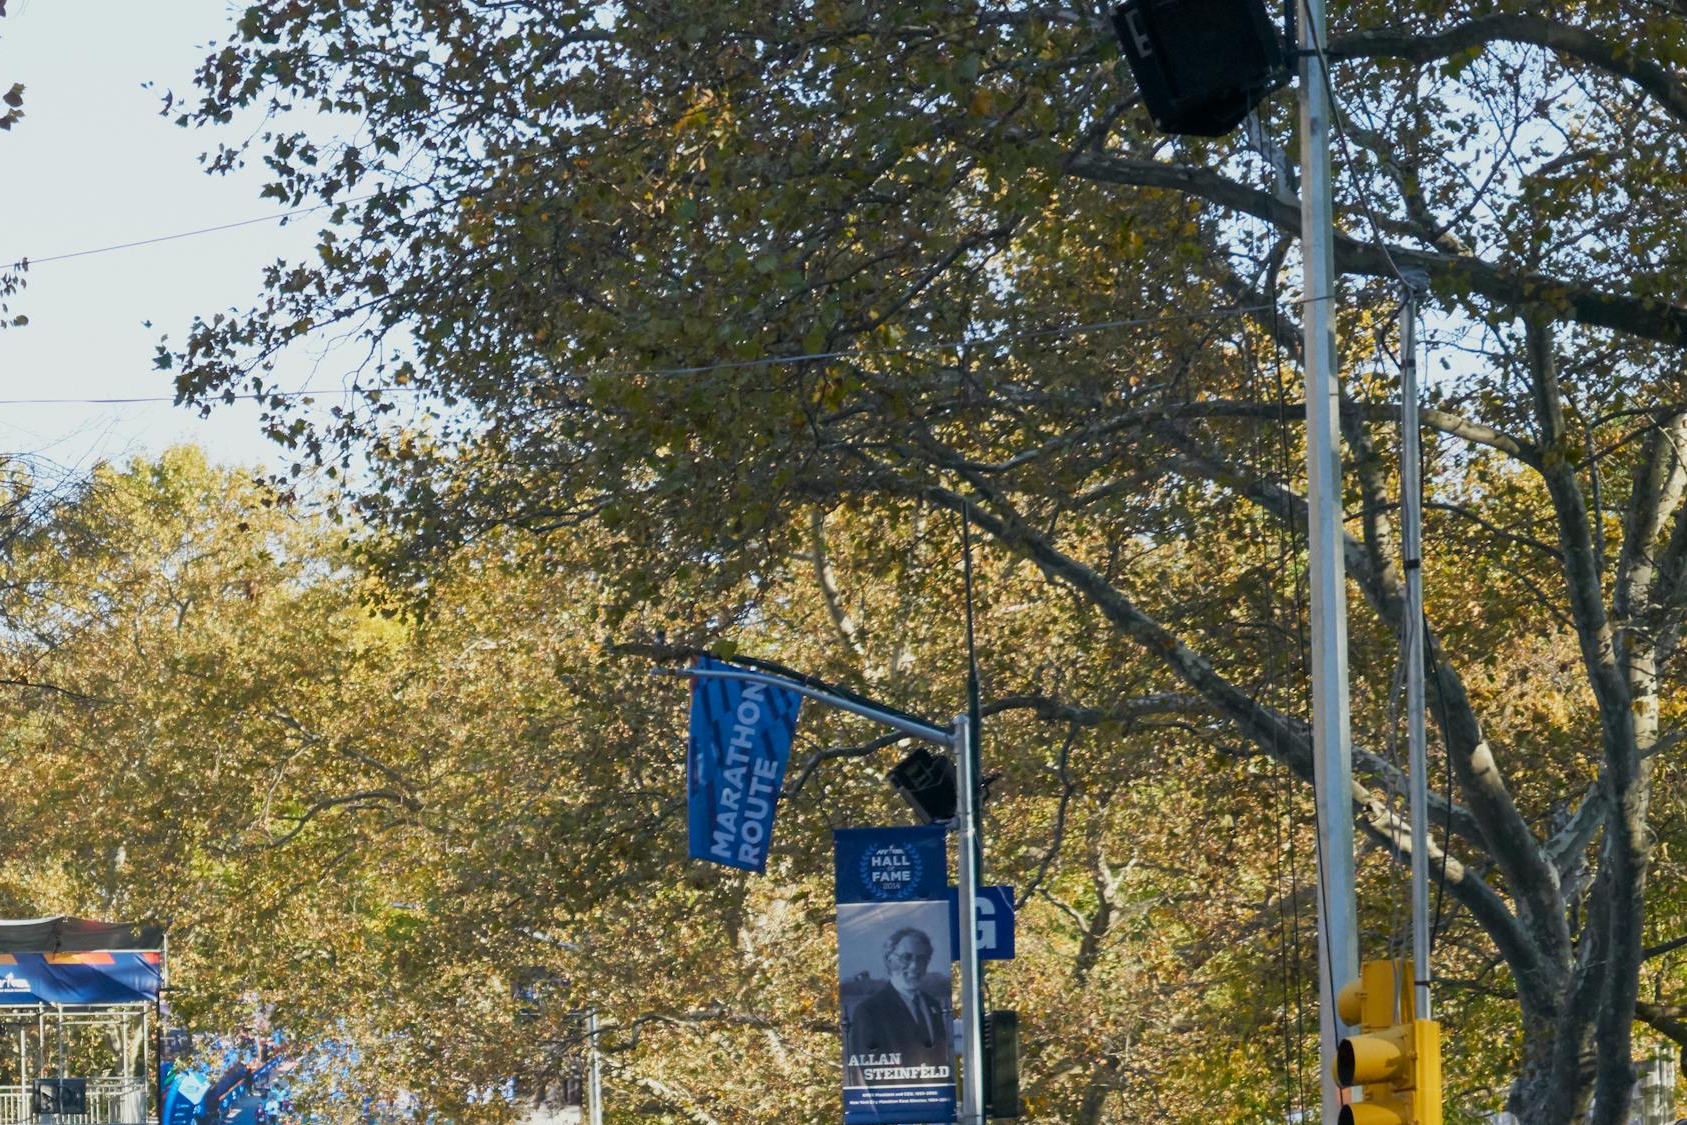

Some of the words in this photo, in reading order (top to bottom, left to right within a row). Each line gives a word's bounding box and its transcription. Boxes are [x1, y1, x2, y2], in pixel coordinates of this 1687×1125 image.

[710, 680, 769, 858] MARATHON
[737, 757, 779, 866] ROUTE
[871, 856, 911, 866] HALL
[872, 870, 911, 882] FAME
[974, 896, 996, 949] G
[848, 1052, 902, 1067] ALLAN
[864, 1064, 951, 1081] STEINFELD
